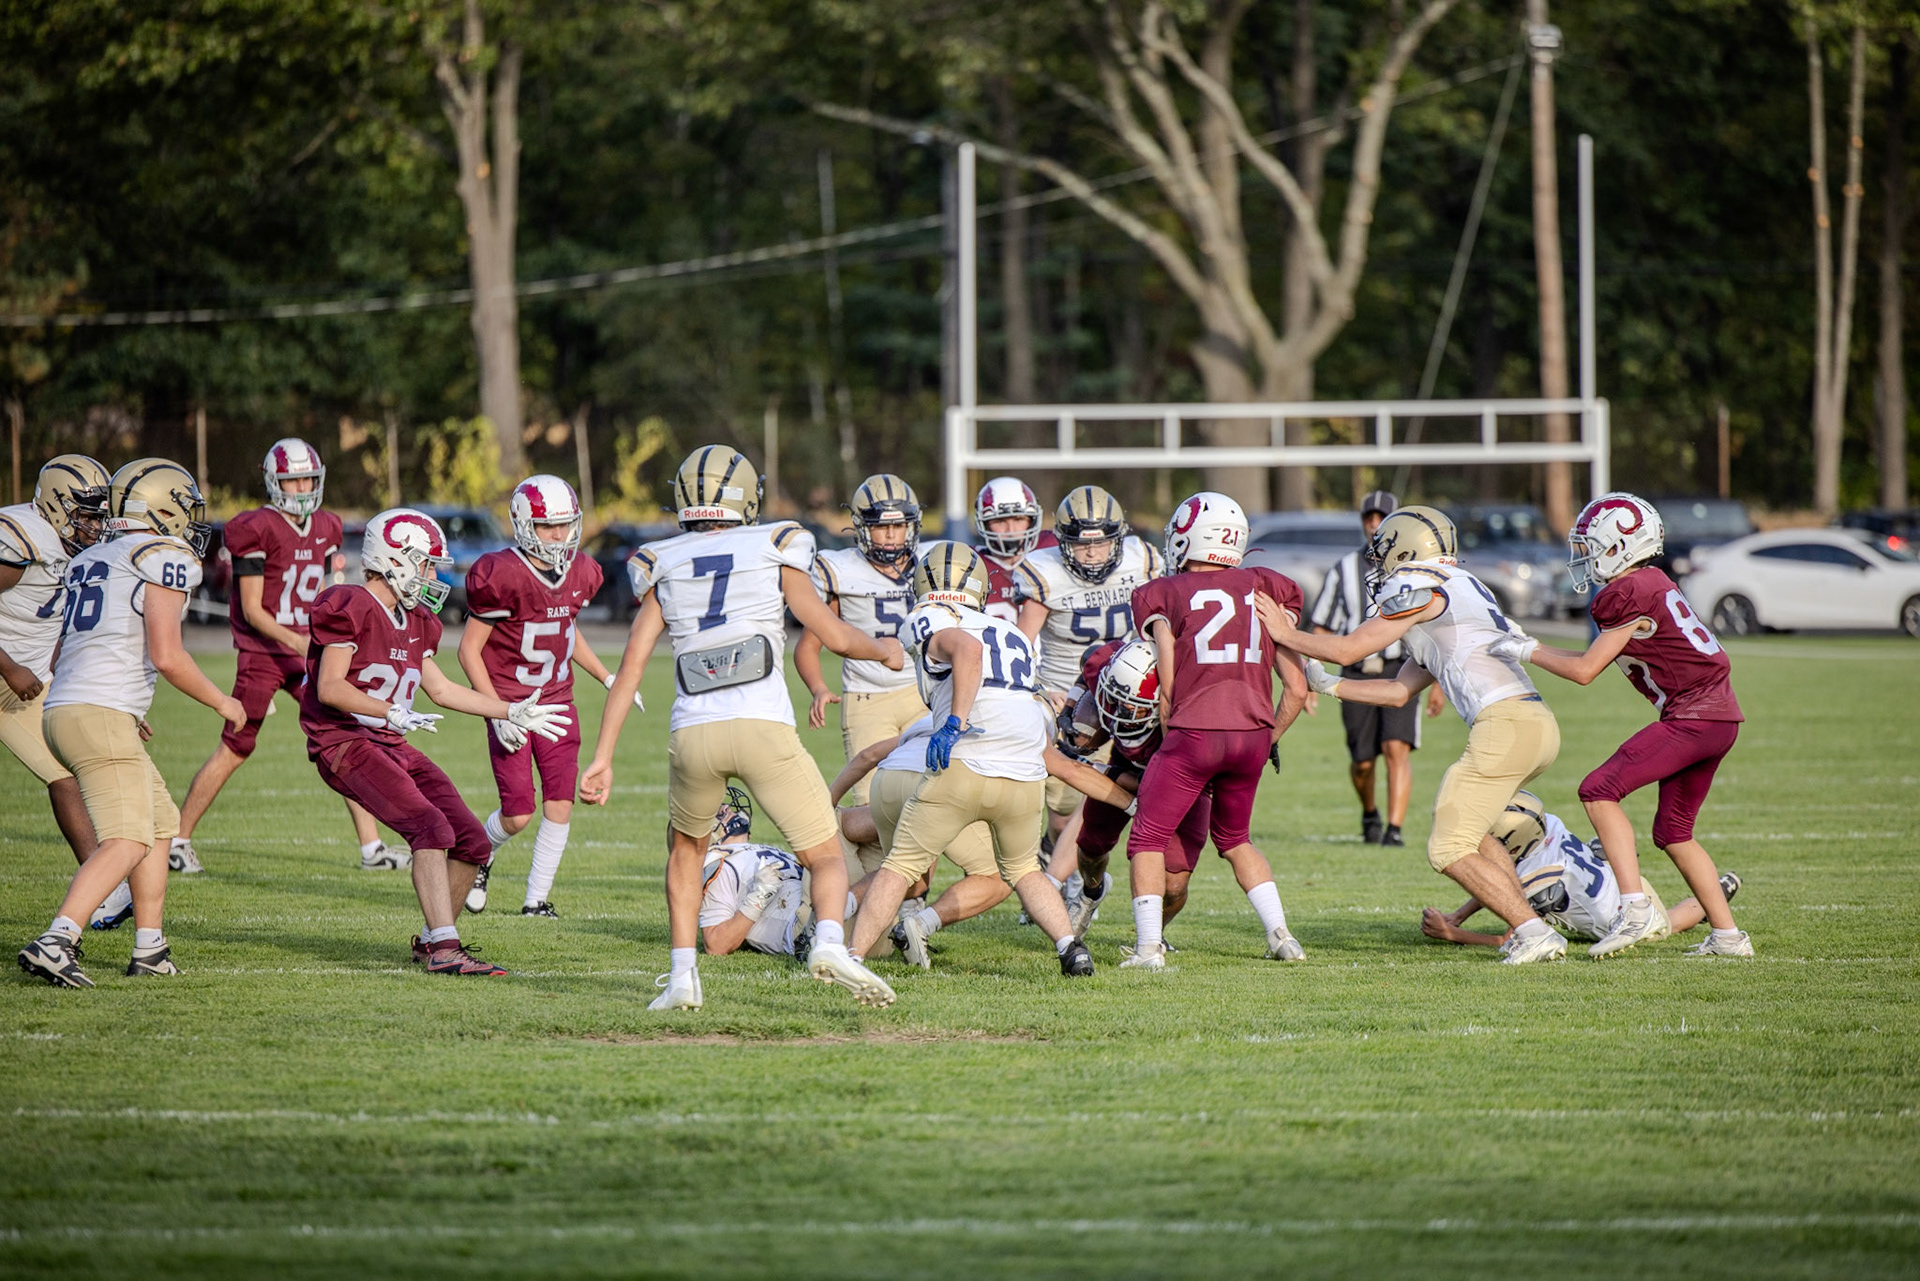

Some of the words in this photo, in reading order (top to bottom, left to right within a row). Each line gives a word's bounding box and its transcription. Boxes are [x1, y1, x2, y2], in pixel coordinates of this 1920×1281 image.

[684, 508, 724, 518] Riddell
[1221, 527, 1239, 547] 21
[1207, 553, 1241, 566] Riddell
[162, 562, 188, 588] 66
[275, 564, 325, 626] 19
[692, 553, 734, 632] 7
[927, 592, 966, 603] Riddell
[1084, 585, 1138, 609] BERNARD
[546, 606, 570, 619] RAMS
[1070, 602, 1134, 646] 50
[1189, 588, 1263, 665] 21
[1665, 588, 1726, 656] 8
[911, 616, 933, 645] 12
[514, 618, 576, 687] 51
[982, 625, 1037, 693] 12
